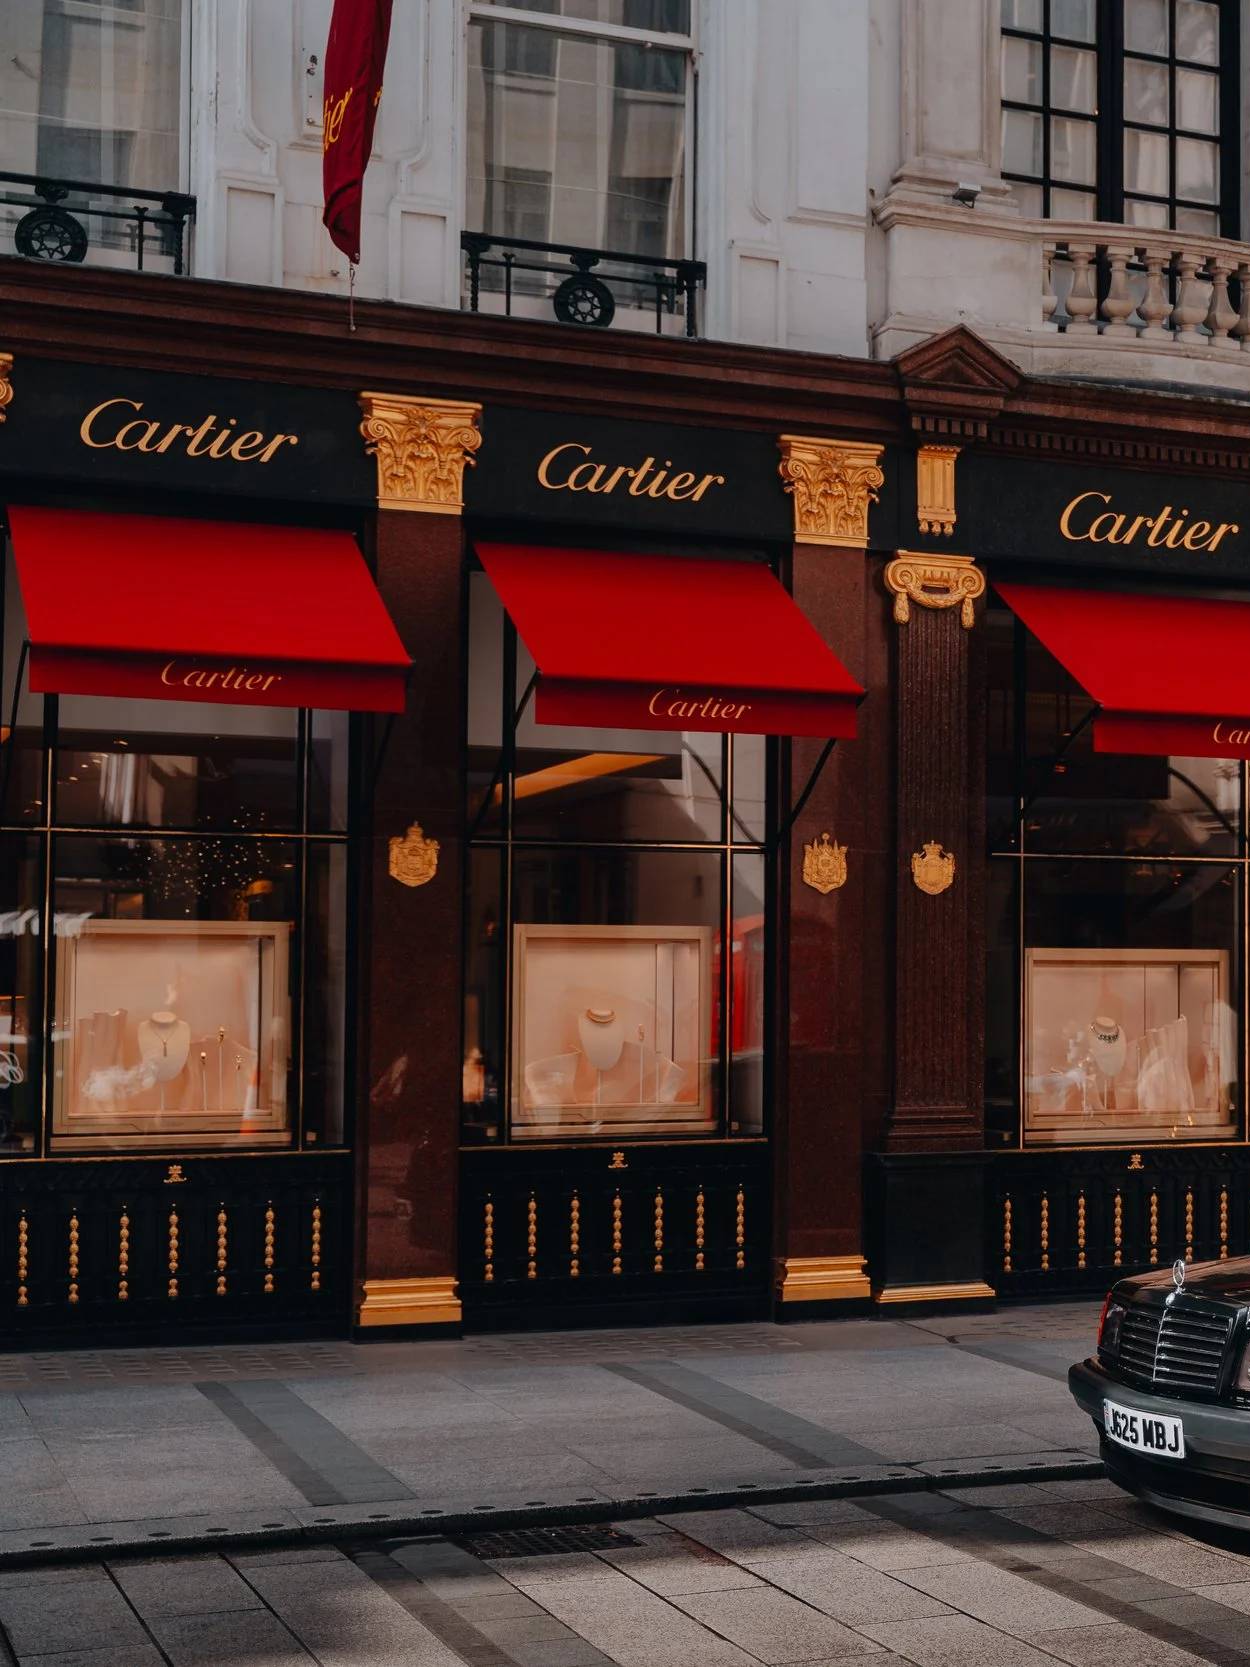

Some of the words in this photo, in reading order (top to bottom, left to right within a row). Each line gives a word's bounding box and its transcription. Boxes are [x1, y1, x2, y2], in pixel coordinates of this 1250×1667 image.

[80, 398, 298, 463] Cartier
[537, 443, 725, 502] Cartier
[1059, 491, 1240, 552] Cartier
[161, 660, 282, 691] Cartier
[648, 688, 752, 719] Cartier
[1110, 1408, 1139, 1444] J625
[1142, 1418, 1180, 1453] MBJ
